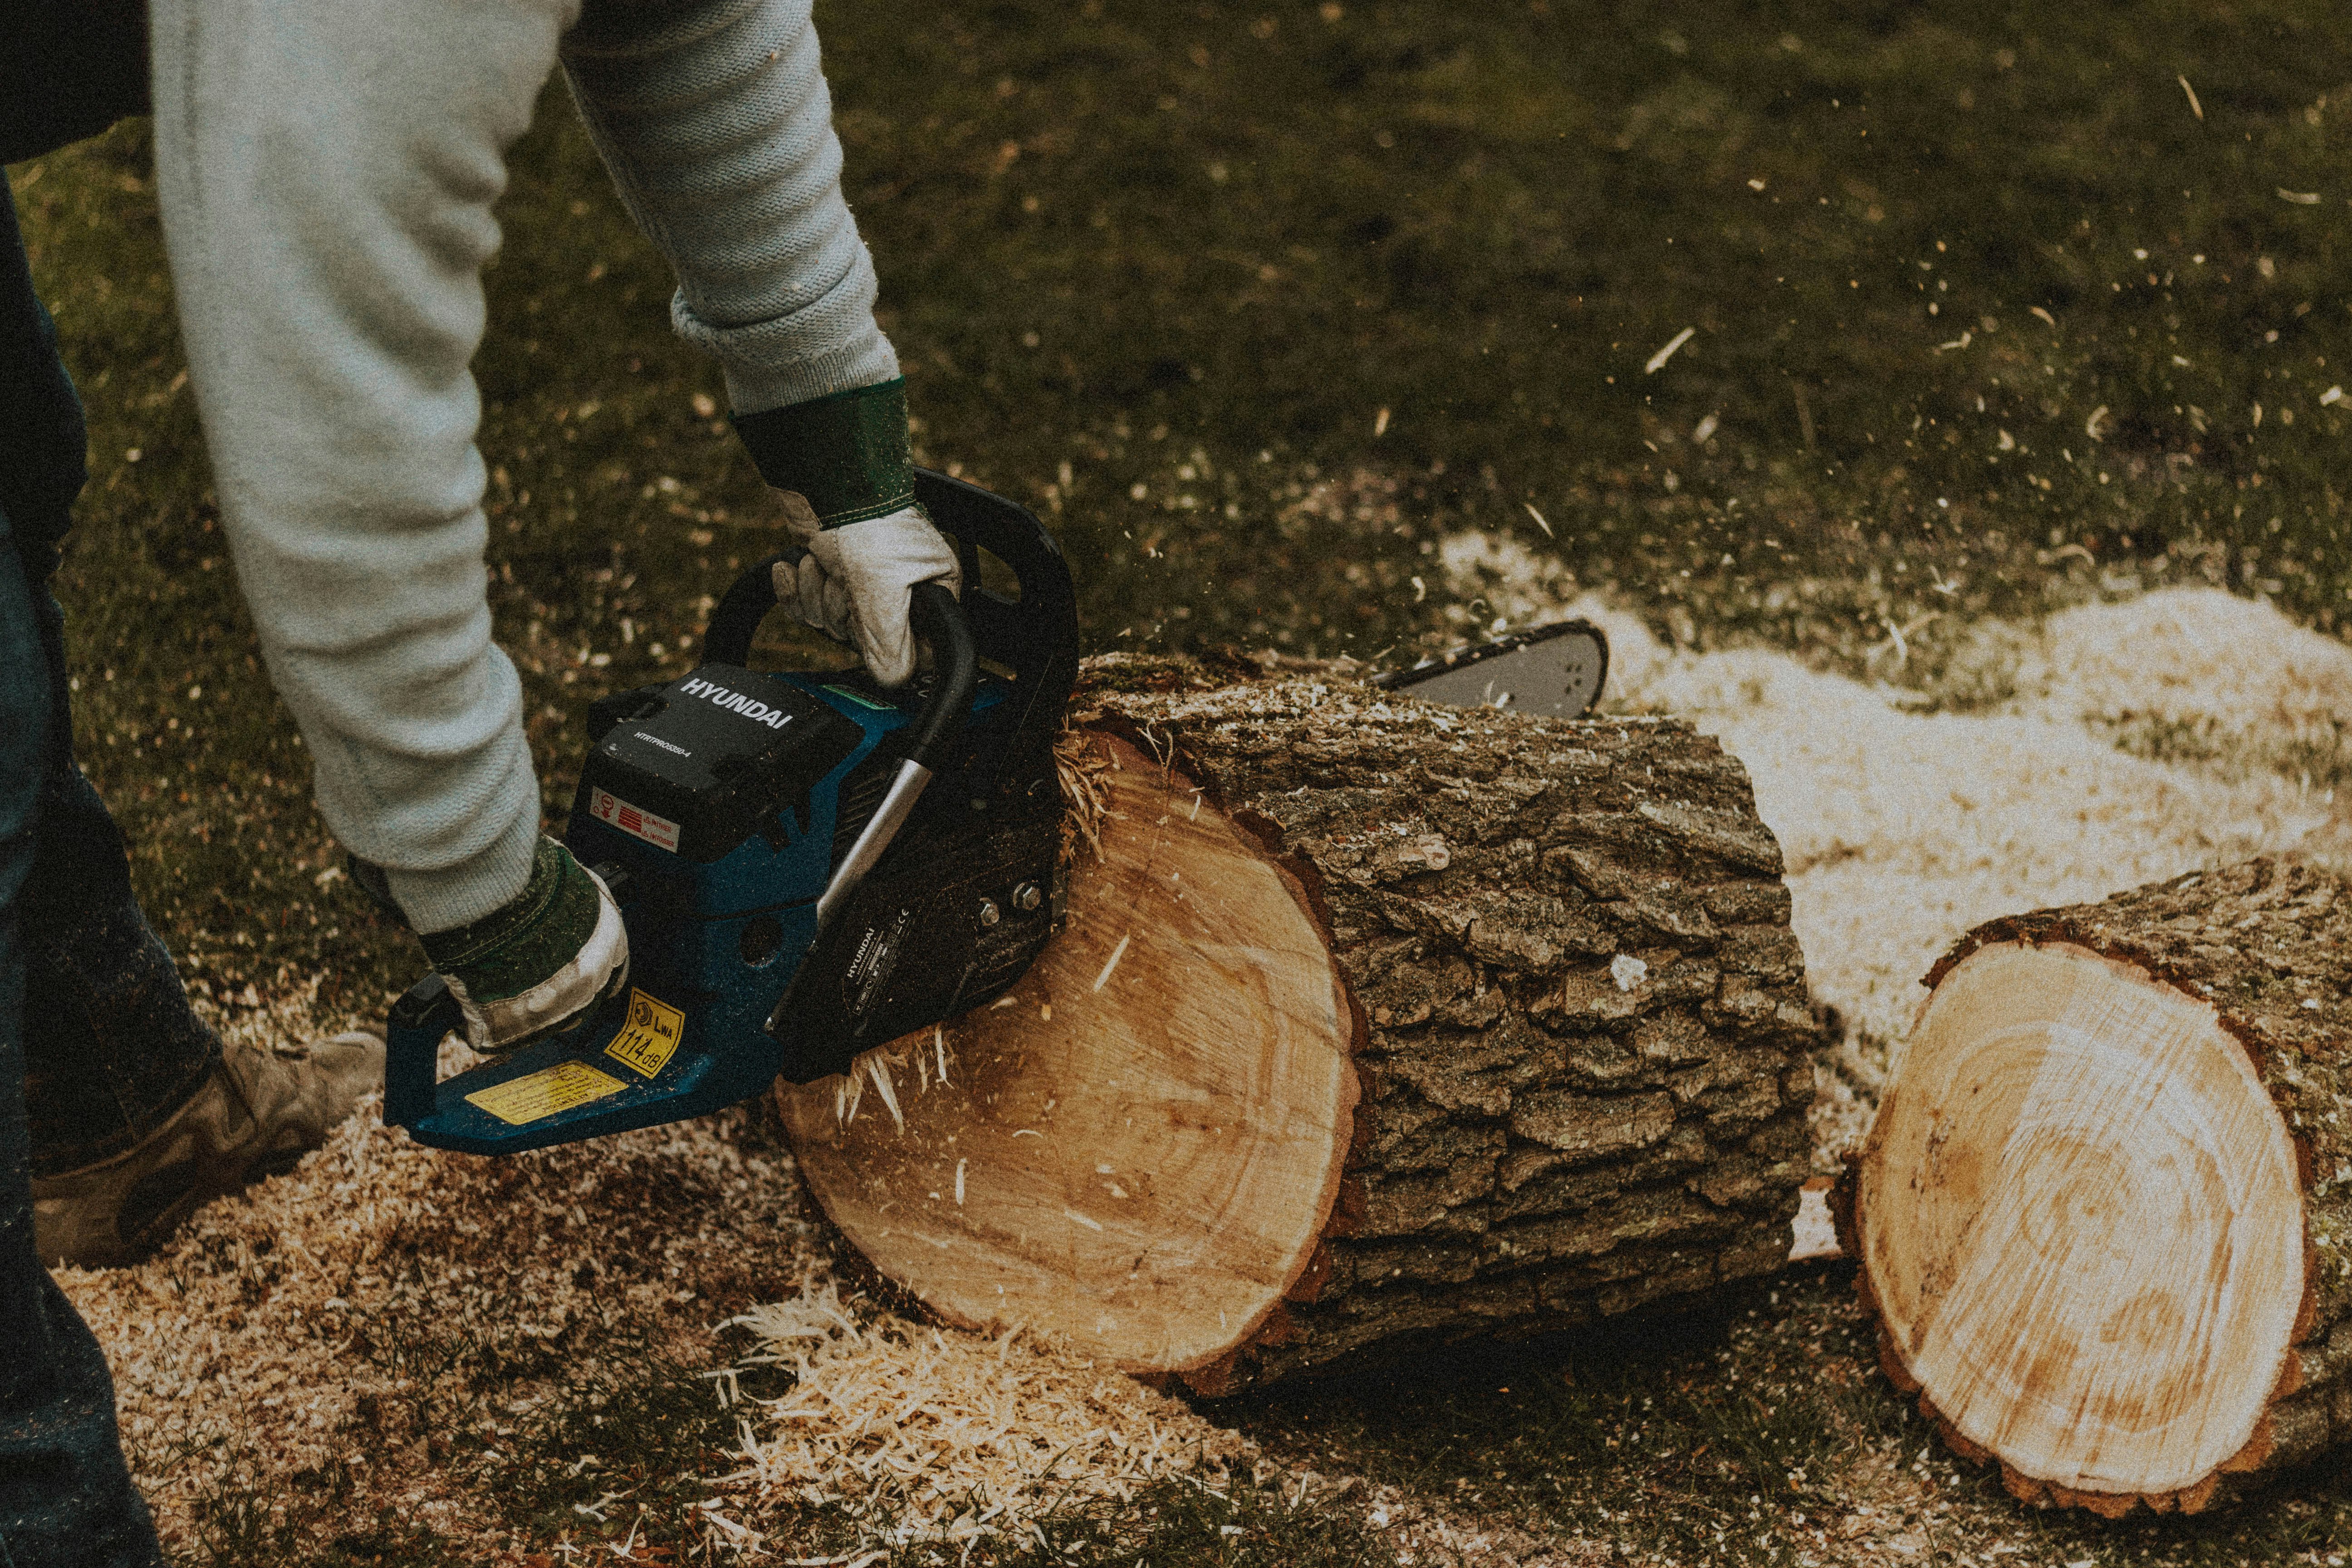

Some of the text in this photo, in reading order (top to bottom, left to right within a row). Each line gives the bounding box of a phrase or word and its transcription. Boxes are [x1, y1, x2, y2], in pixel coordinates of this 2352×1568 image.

[681, 678, 793, 729] HYUNDAI
[634, 731, 692, 757] HTRTPRO5350-4
[657, 835, 674, 848] POUSSER
[658, 823, 671, 833] TIRER
[847, 927, 875, 978] HYUNDAI
[619, 1029, 661, 1068] 114 dB
